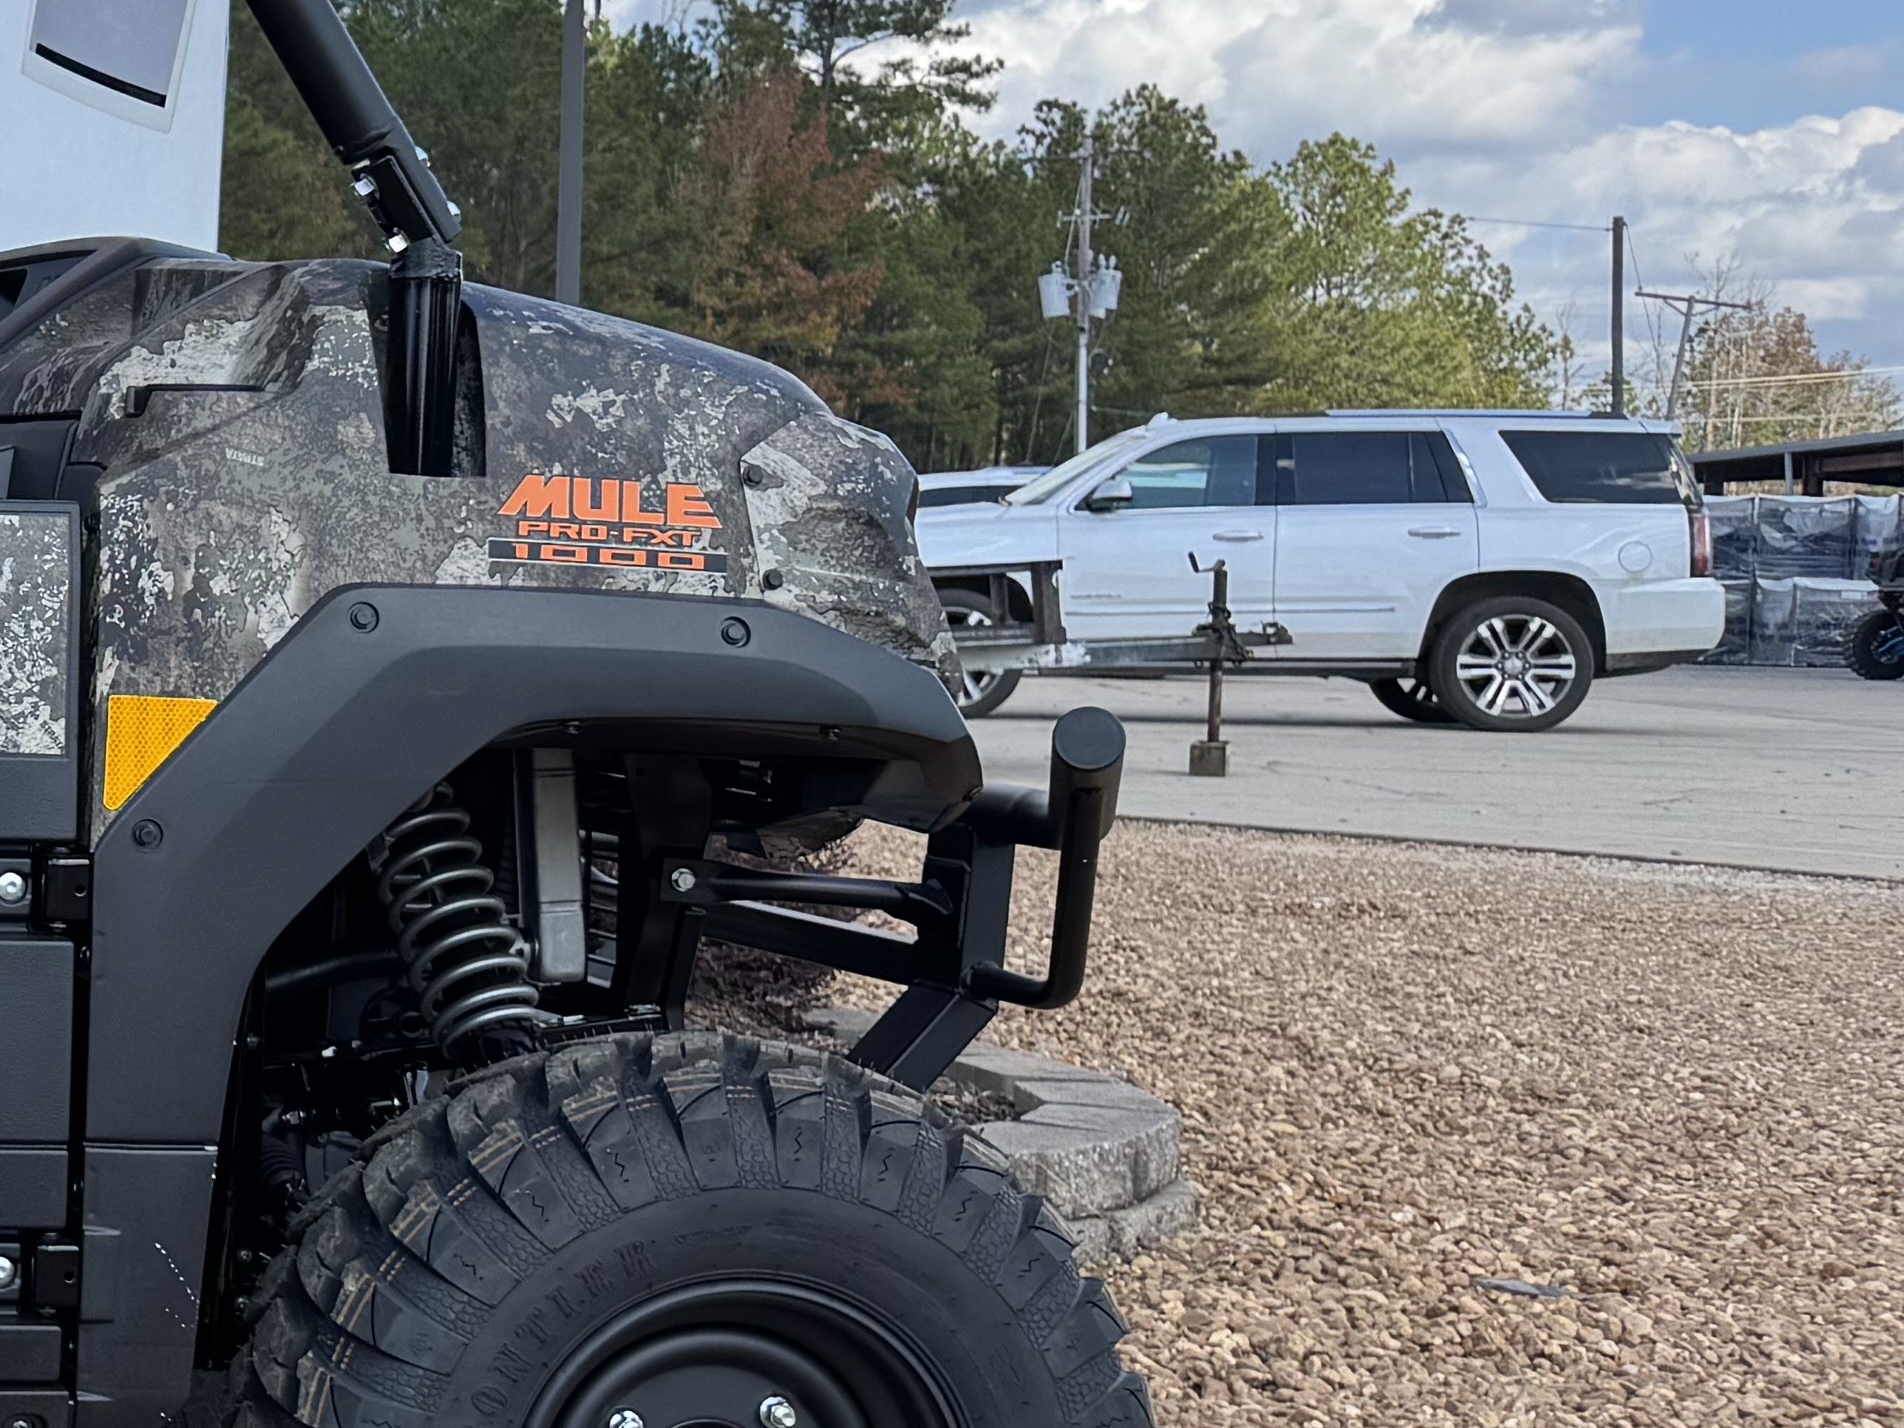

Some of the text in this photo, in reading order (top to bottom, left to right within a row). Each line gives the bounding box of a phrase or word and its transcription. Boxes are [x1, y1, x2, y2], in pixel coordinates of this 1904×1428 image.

[498, 474, 723, 529] MULE
[518, 521, 703, 548] PRO-FXT
[511, 543, 706, 571] 1000
